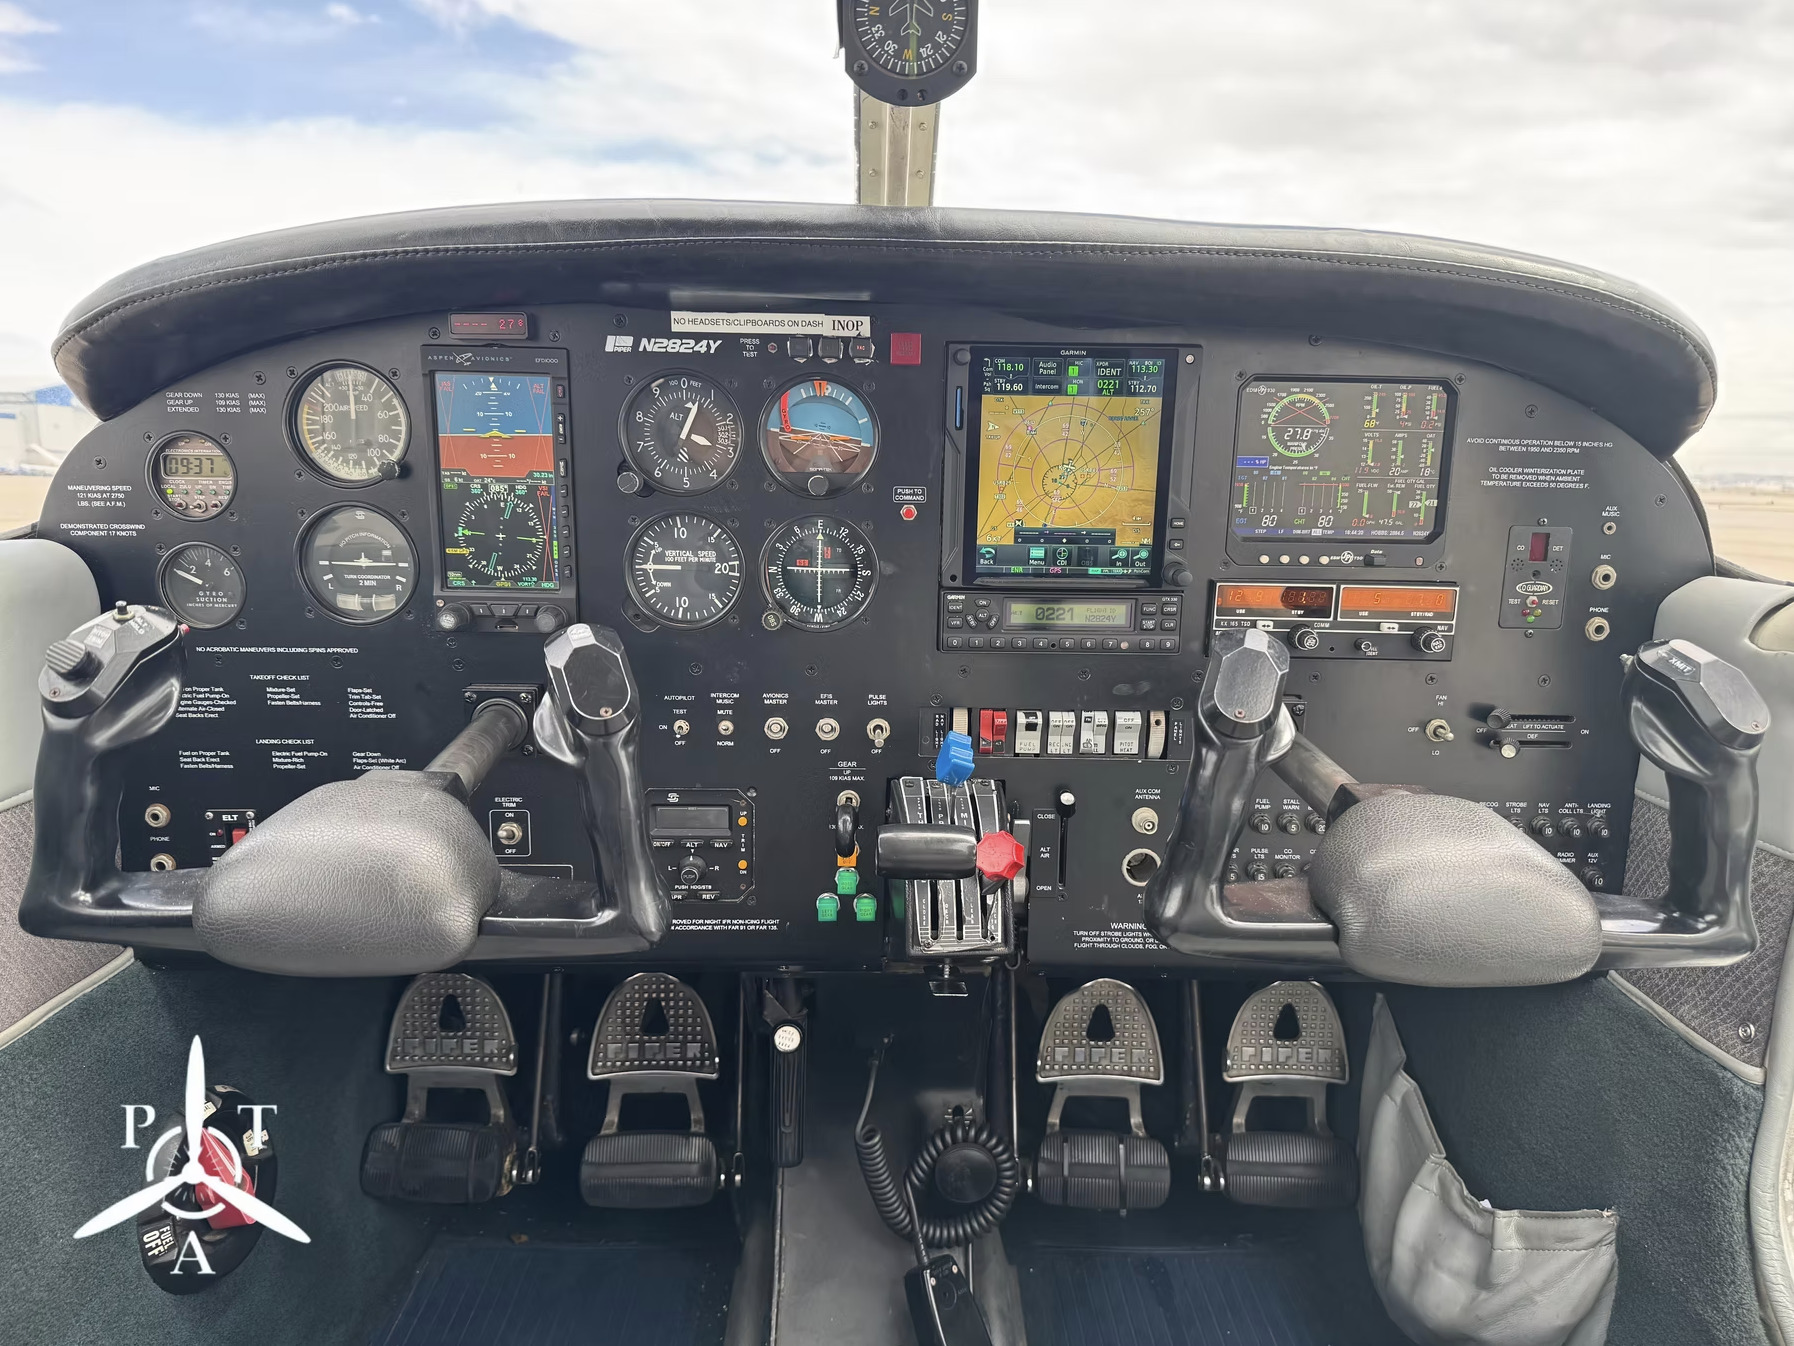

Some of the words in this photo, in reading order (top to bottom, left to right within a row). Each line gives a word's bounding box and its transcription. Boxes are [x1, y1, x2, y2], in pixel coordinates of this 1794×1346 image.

[869, 6, 880, 15] N
[942, 13, 952, 21] S
[884, 41, 898, 55] 30
[920, 43, 933, 57] 24
[688, 318, 786, 327] HEADSETS/CLIPBOARDS
[801, 320, 824, 328] DASH
[832, 320, 863, 332] INOP
[638, 338, 722, 354] N2824Y
[997, 363, 1024, 372] 118.10
[1097, 368, 1122, 376] IDENT
[1131, 365, 1159, 373] 113.30
[996, 383, 1023, 391] 119.60
[1097, 379, 1120, 389] 0221
[1130, 385, 1157, 393] 112.70
[669, 412, 684, 421] ALT
[1284, 428, 1312, 440] 27.8
[1262, 515, 1277, 527] 80
[1318, 516, 1334, 527] 80
[673, 528, 687, 539] 10
[665, 550, 691, 558] VERTICAL
[698, 550, 716, 558] SPEED
[714, 563, 729, 574] 20
[675, 597, 689, 607] 10
[1035, 607, 1075, 621] 0221
[1085, 614, 1116, 623] N2824Y
[1668, 657, 1694, 674] XMIT
[142, 1231, 162, 1257] OFF
